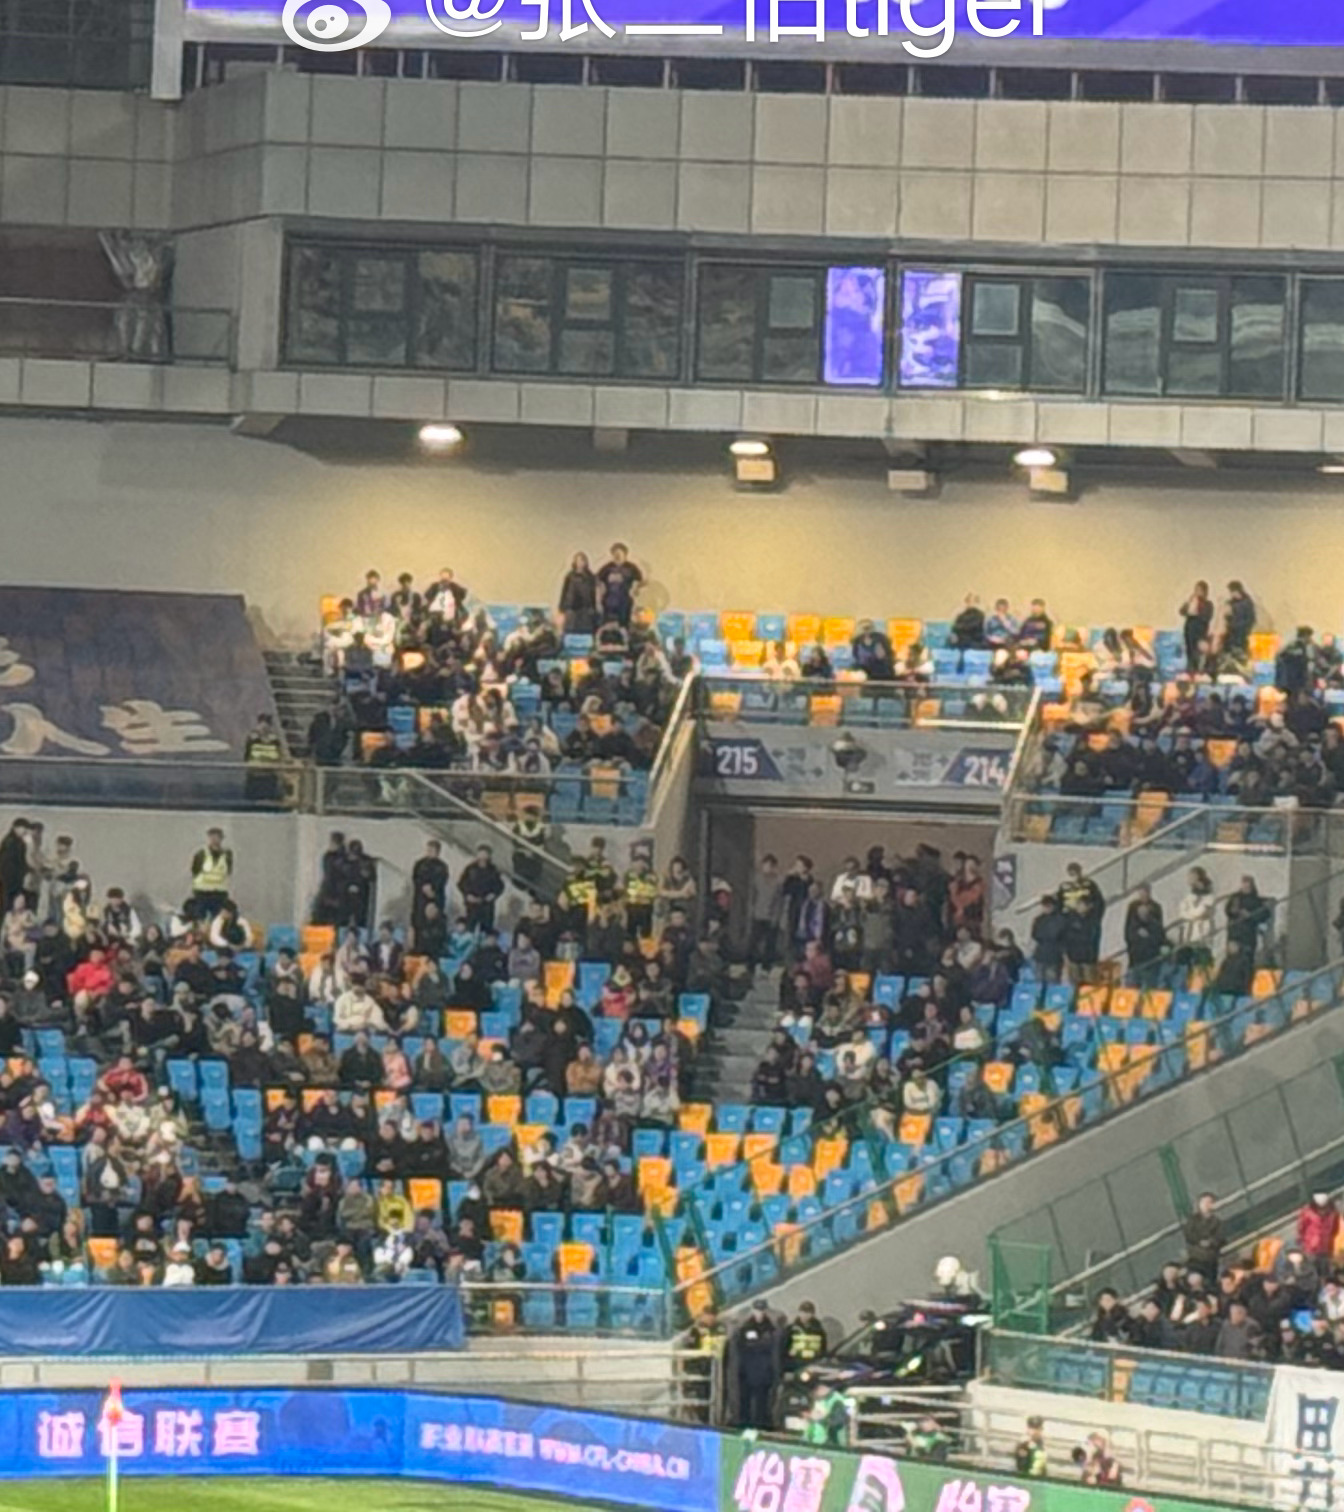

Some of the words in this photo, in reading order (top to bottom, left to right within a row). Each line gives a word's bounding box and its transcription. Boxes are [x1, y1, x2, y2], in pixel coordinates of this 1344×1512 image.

[716, 746, 759, 776] 215
[965, 755, 1005, 787] 214
[37, 1409, 260, 1458] 诚信联赛
